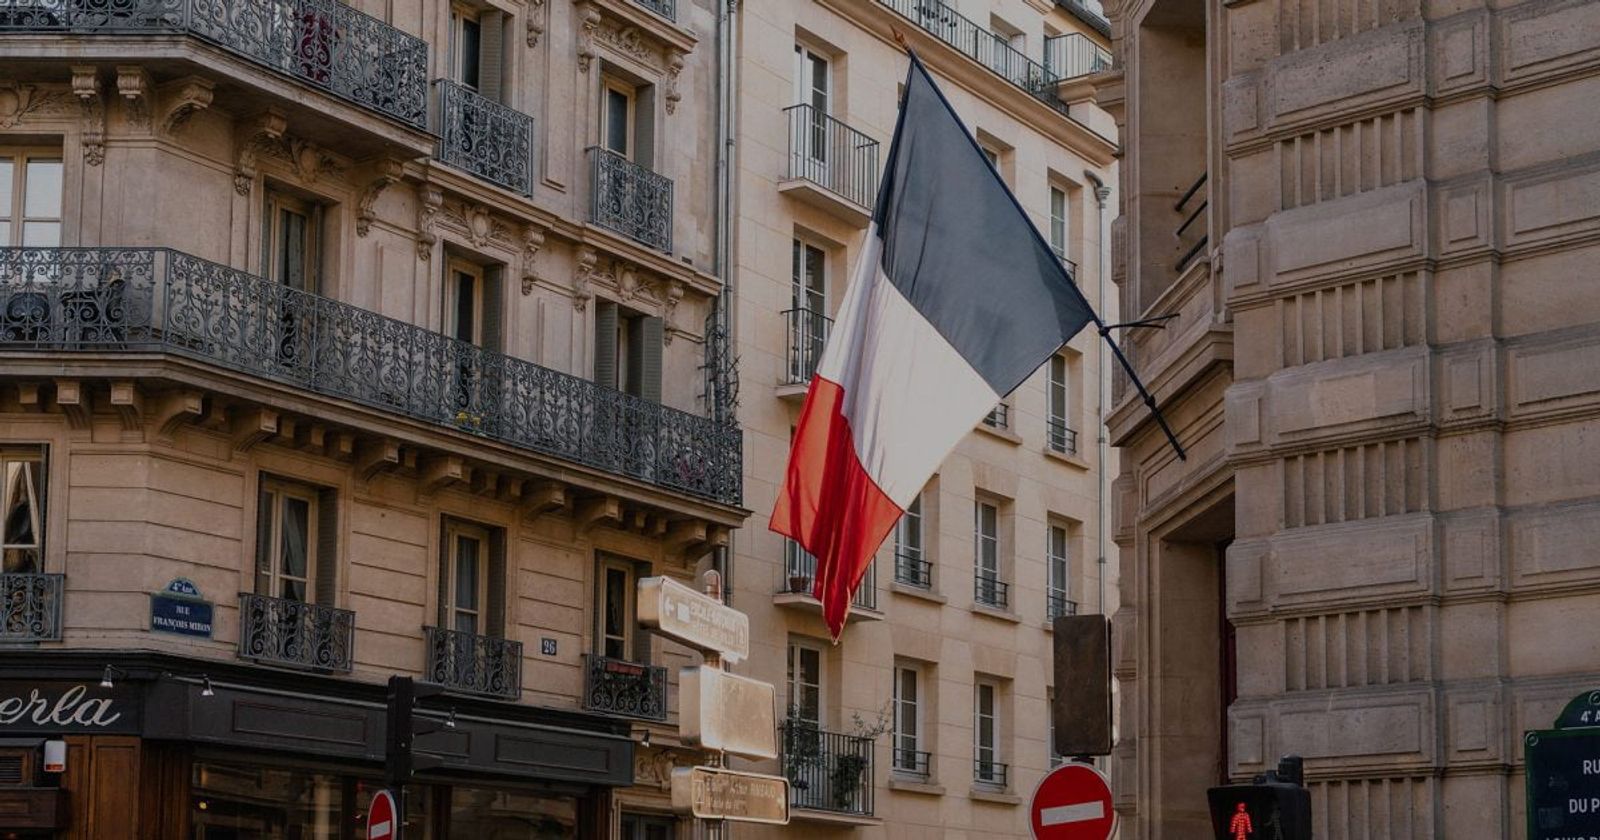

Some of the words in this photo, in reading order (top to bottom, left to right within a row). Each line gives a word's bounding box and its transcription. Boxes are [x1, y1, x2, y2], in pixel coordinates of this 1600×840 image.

[176, 605, 190, 615] RUE
[153, 615, 188, 630] FRANÇOIS
[544, 640, 555, 654] 26
[0, 685, 120, 726] erla
[1569, 799, 1588, 813] DU
